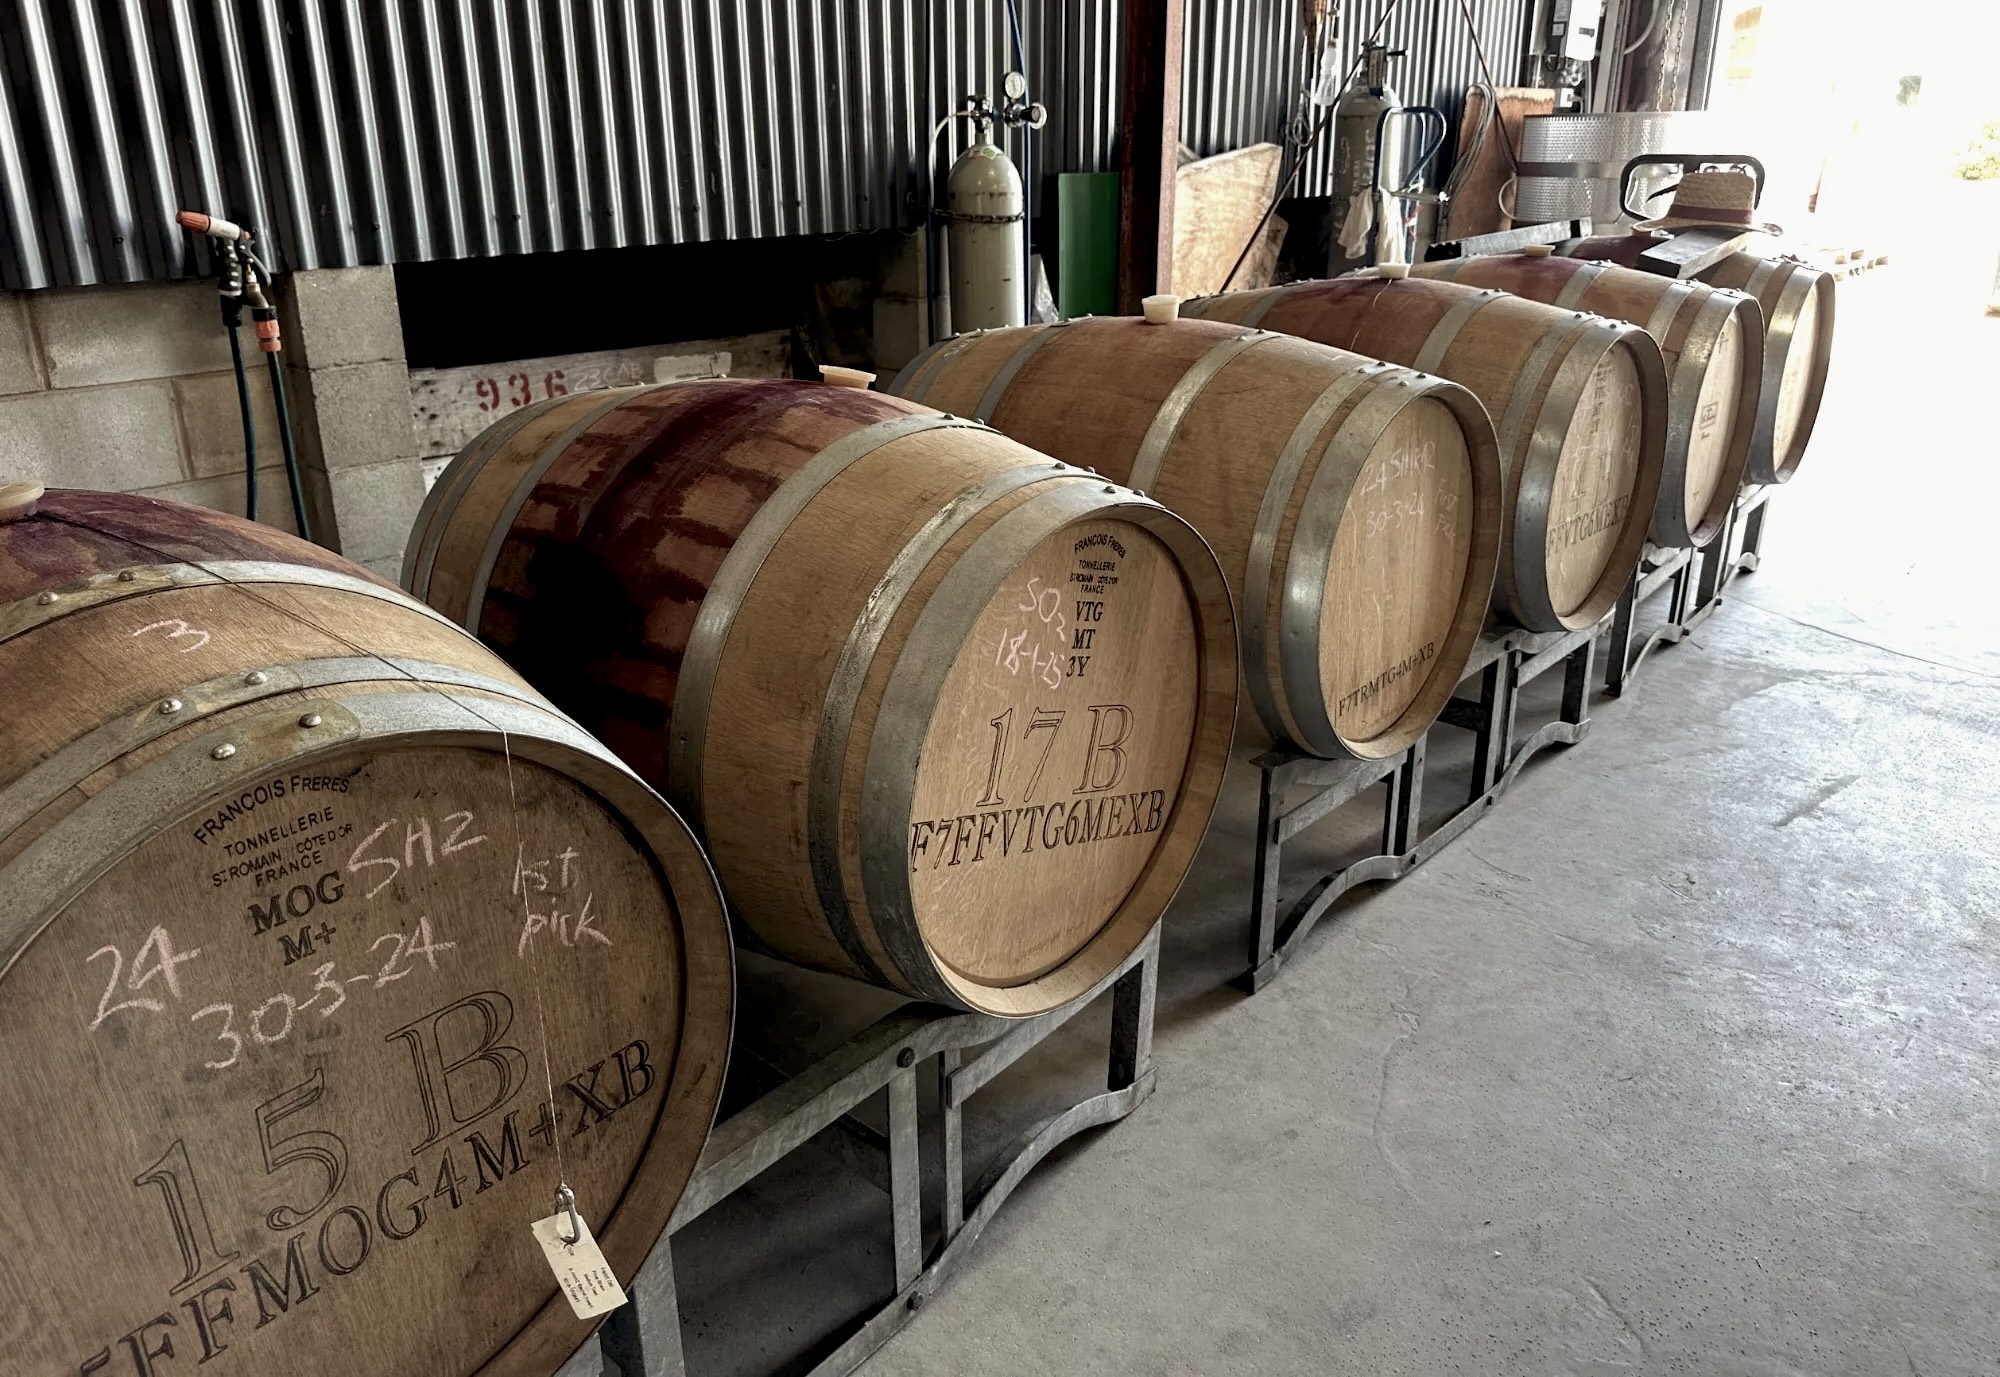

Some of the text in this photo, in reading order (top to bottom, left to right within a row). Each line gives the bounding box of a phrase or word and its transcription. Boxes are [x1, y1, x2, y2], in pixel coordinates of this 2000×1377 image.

[1360, 462, 1387, 496] 24
[1081, 584, 1105, 594] FRANCE
[1076, 601, 1104, 621] VTG
[1071, 629, 1096, 649] MT
[1066, 656, 1090, 678] 3Y
[976, 704, 1134, 807] 17 B
[224, 806, 334, 858] TONNELLERIE
[910, 789, 1166, 872] F7FFVTG6MEXB
[230, 850, 282, 880] ROMAIN
[255, 851, 323, 887] FRANCE
[248, 871, 345, 936] MOG
[278, 922, 336, 966] M+
[87, 925, 201, 1031] 24
[133, 990, 528, 1296] 15 B
